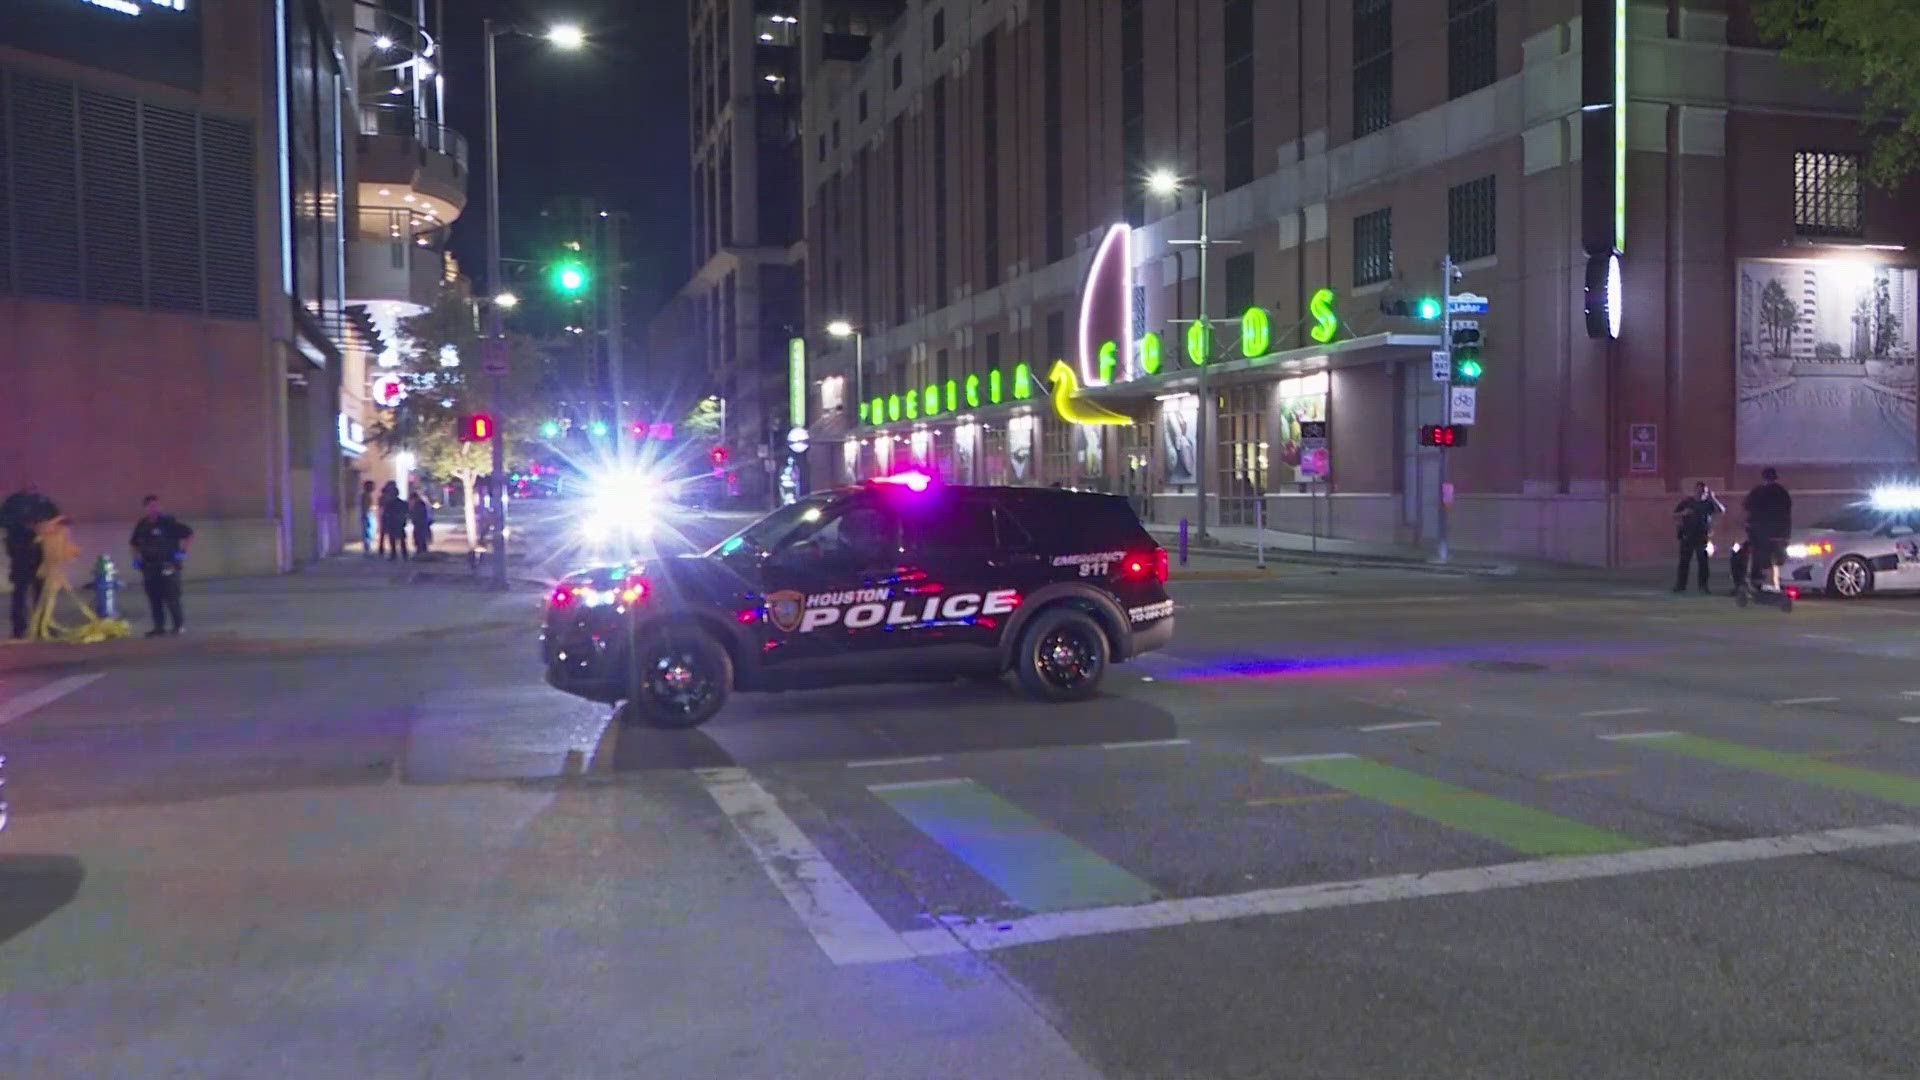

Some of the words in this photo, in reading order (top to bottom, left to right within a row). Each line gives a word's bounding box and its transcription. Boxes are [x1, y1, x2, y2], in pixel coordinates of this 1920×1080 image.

[1099, 288, 1338, 385] FOODS
[1434, 353, 1448, 361] ONE
[1434, 362, 1448, 370] WAY
[1052, 551, 1127, 567] EMERGENCY
[1078, 562, 1109, 577] 911
[806, 587, 890, 608] HOUSTON
[799, 588, 1018, 633] POLICE
